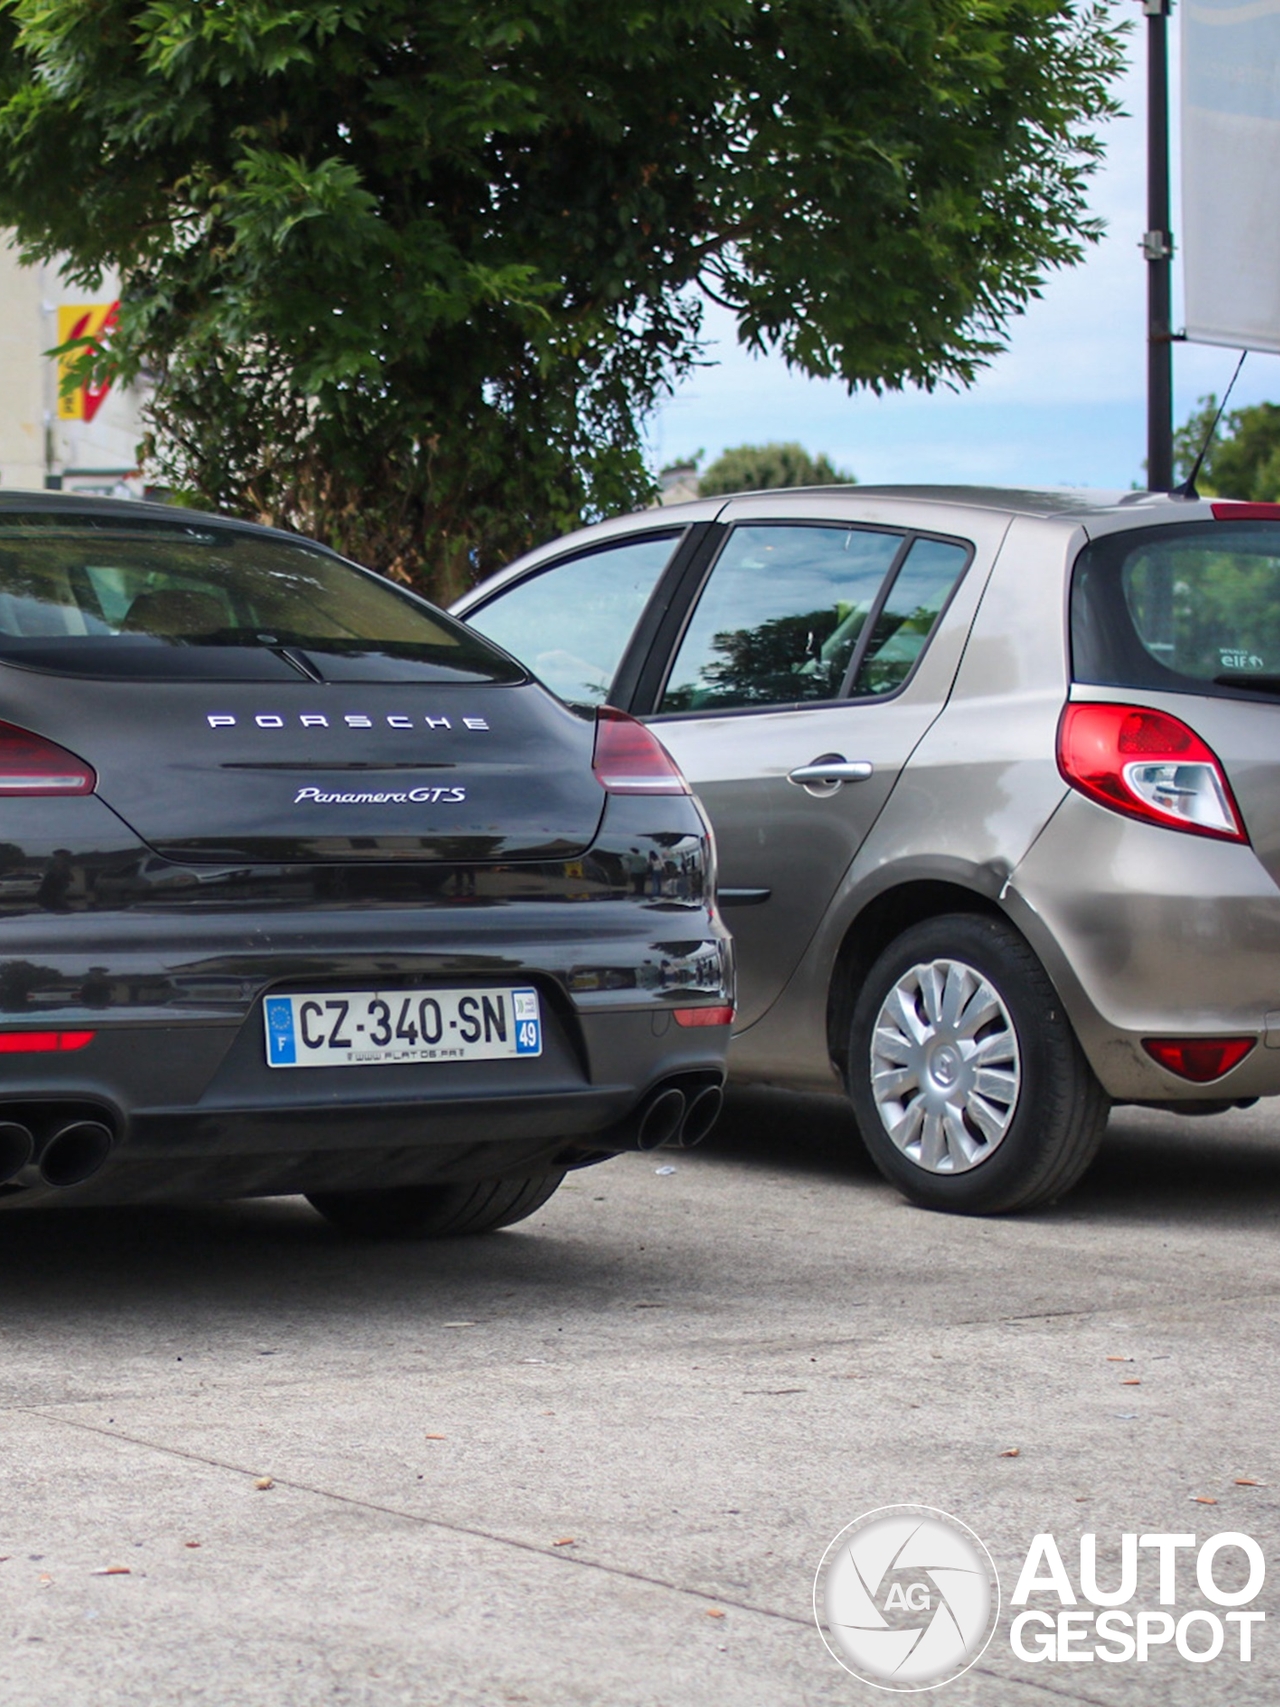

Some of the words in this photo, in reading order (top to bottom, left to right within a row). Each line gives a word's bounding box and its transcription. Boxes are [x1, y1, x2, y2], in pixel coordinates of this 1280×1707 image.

[207, 714, 491, 732] PORSCHE
[299, 994, 508, 1050] CZ-340-SN
[277, 1036, 287, 1052] F
[519, 1021, 537, 1048] 49
